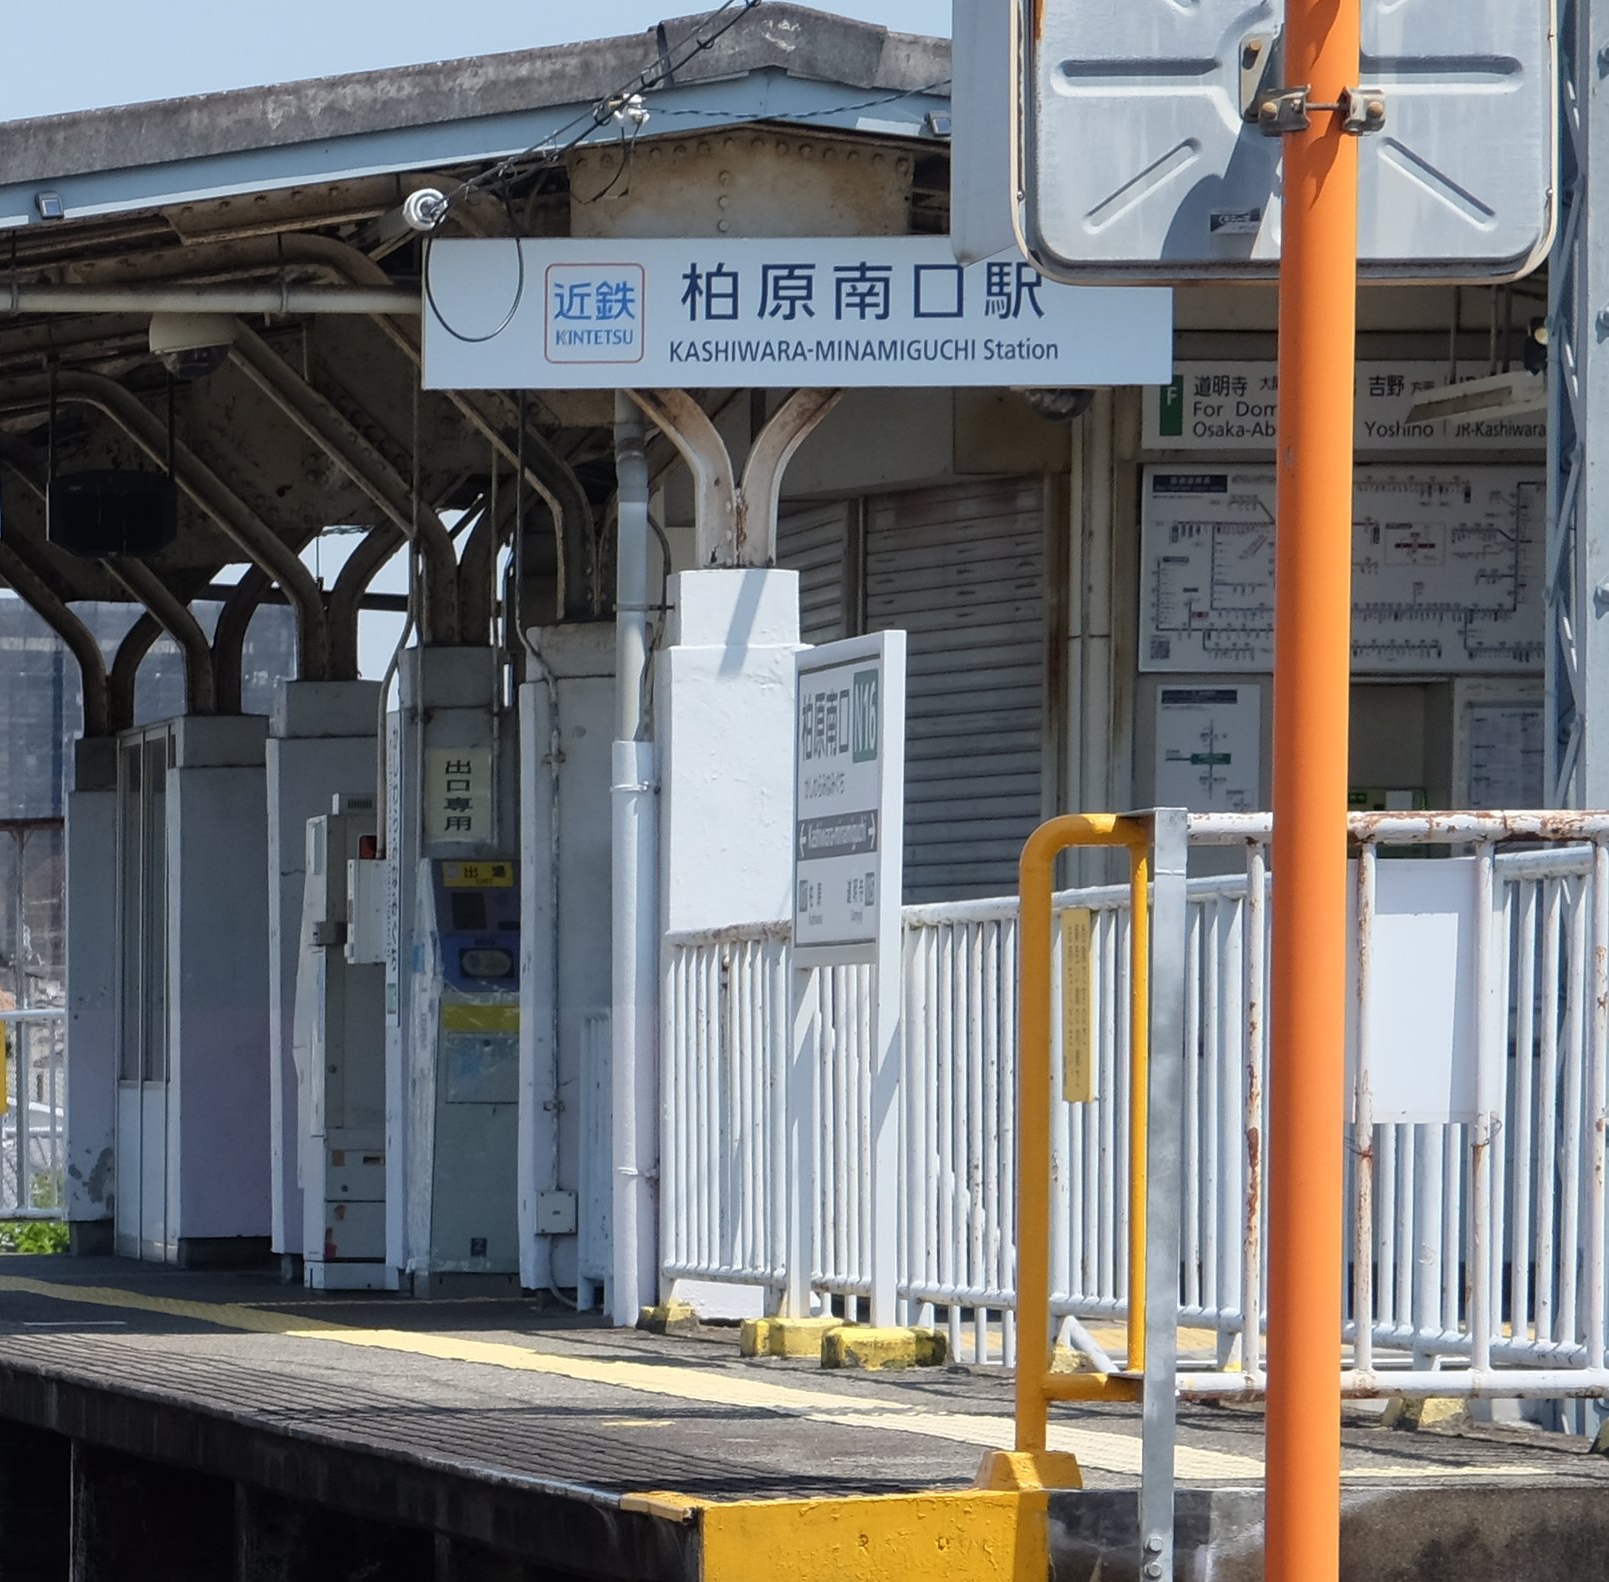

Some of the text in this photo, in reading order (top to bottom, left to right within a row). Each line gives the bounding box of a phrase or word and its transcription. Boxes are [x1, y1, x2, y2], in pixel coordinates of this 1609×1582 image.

[554, 281, 635, 321] 近鉄
[681, 261, 1045, 320] 柏原南口駅
[555, 329, 633, 346] KINTETSU
[669, 337, 1059, 362] KASHIWARA-MINAMIGUCHI Station
[1167, 386, 1178, 406] F
[1193, 375, 1249, 398] 道明寺
[1369, 374, 1405, 397] 吉野
[1193, 402, 1222, 418] For
[1365, 421, 1434, 438] Yoshino
[802, 688, 850, 760] 柏原南口
[854, 680, 876, 753] N16
[443, 759, 473, 832] 出口専用
